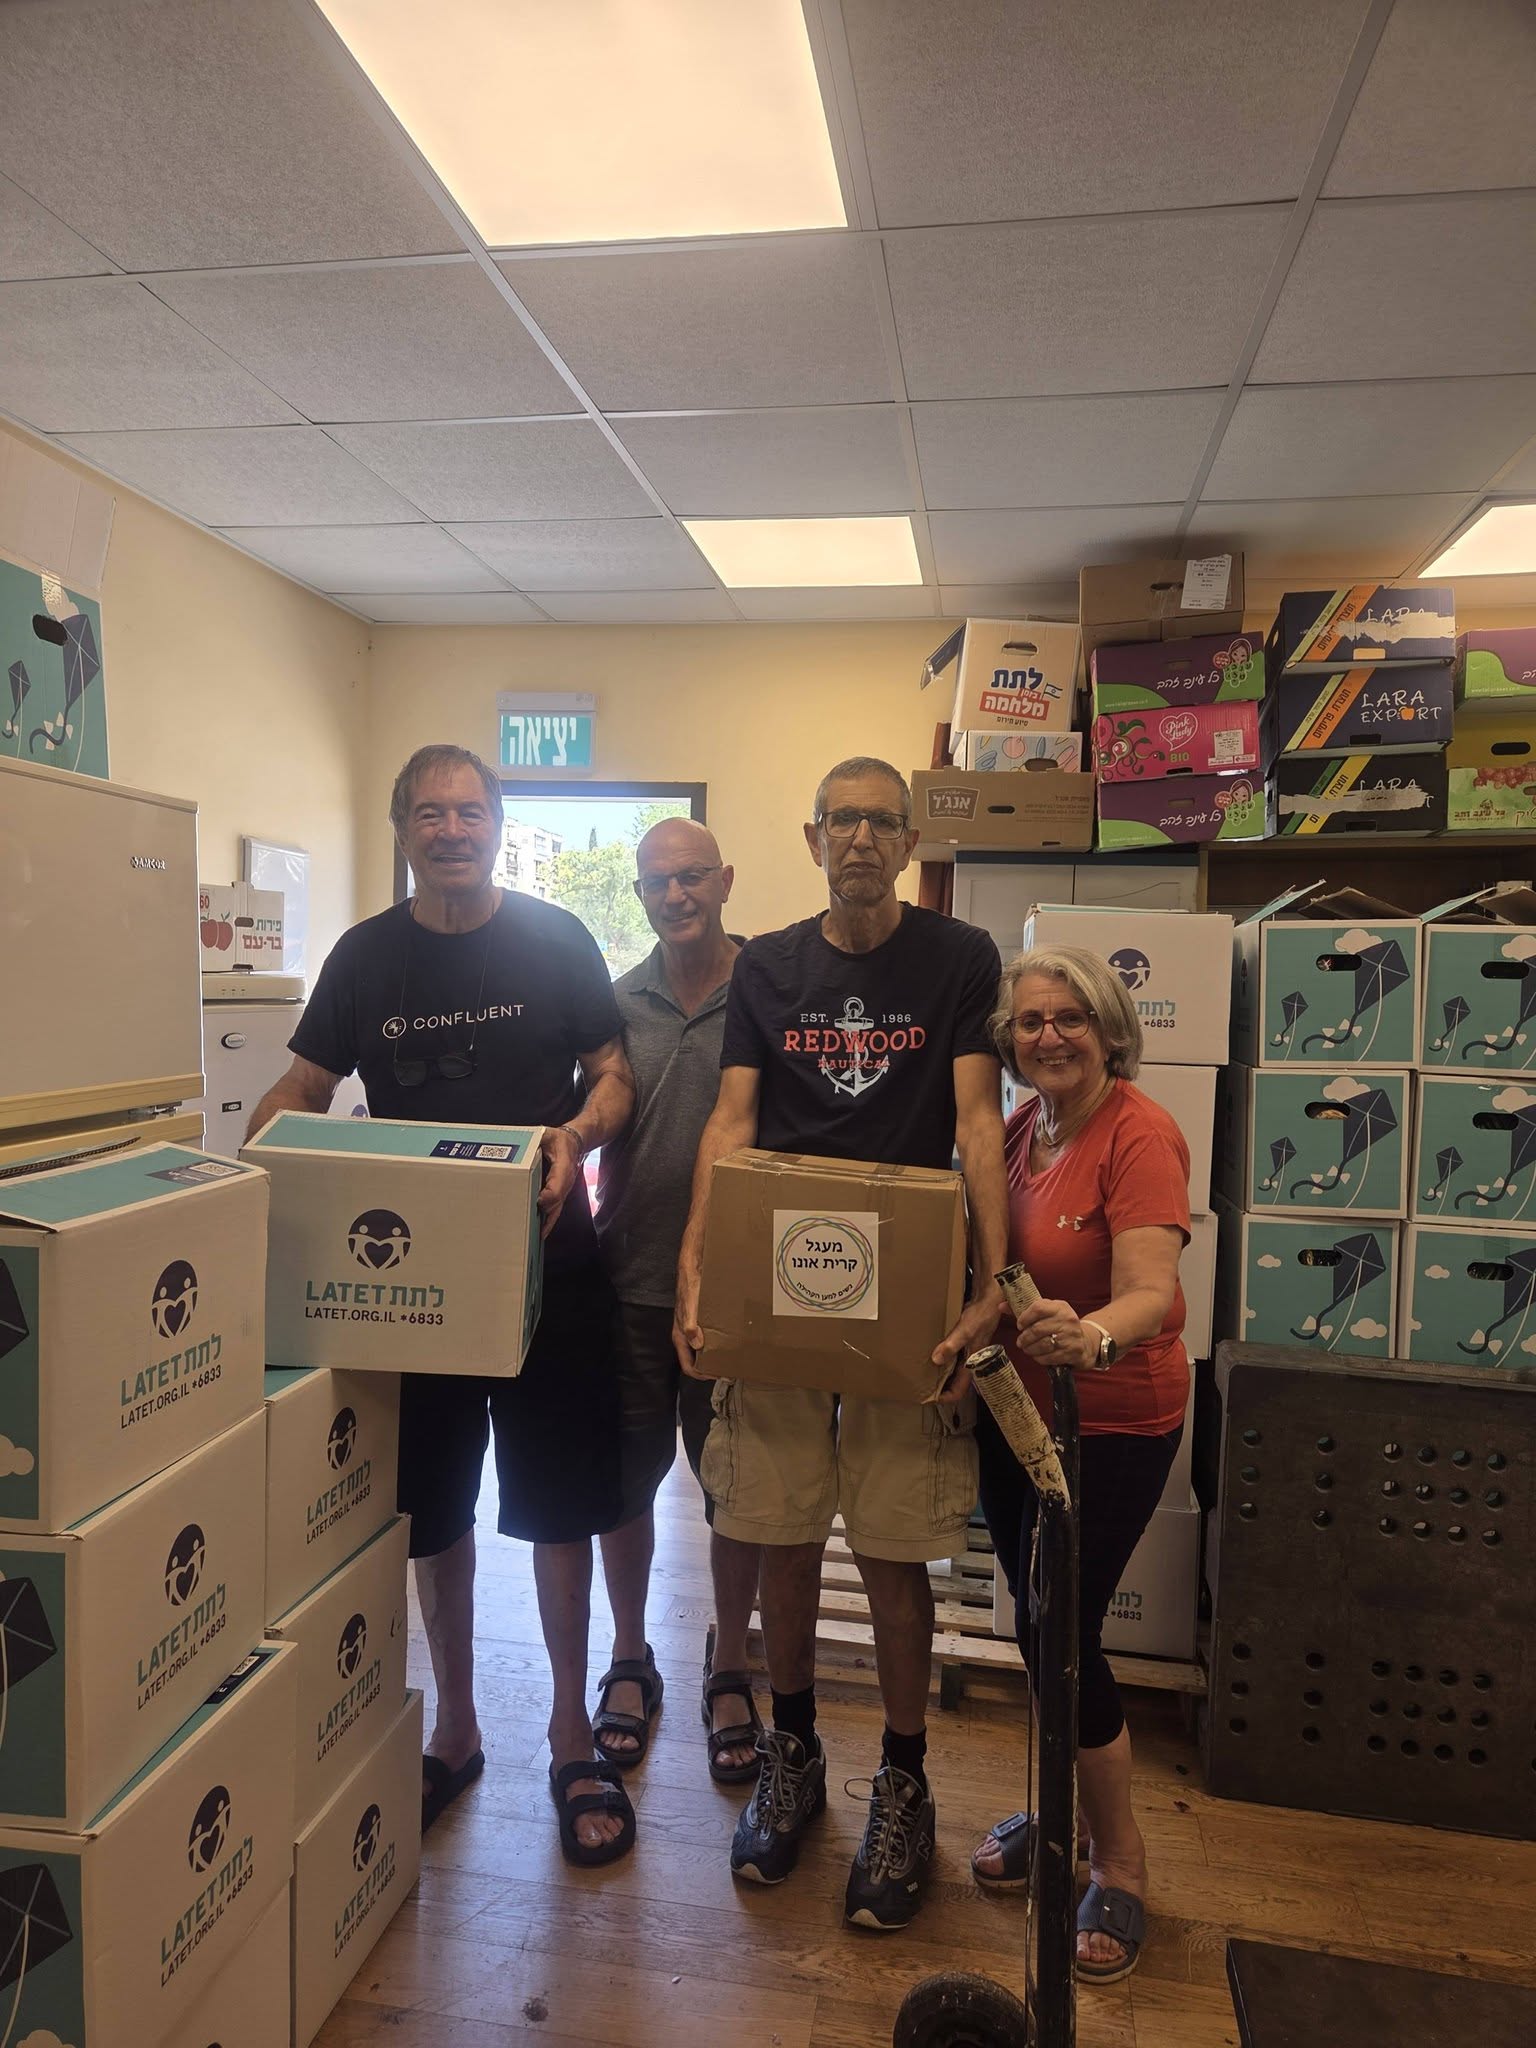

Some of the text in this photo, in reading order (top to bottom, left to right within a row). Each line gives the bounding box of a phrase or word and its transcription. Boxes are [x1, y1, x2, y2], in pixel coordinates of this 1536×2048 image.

[991, 667, 1043, 690] לתת
[1156, 677, 1180, 690] זהב
[1207, 670, 1220, 683] כל
[1020, 688, 1039, 700] בזמן
[1361, 689, 1425, 708] LARA
[984, 695, 1045, 717] מלחמה
[1165, 715, 1190, 734] Pink
[1170, 726, 1195, 741] Lady
[509, 716, 577, 766] יציאה
[1169, 752, 1190, 763] BIO
[933, 794, 971, 810] אנג'ל
[1159, 815, 1183, 827] זהב
[1209, 809, 1222, 822] כל
[256, 919, 282, 932] פירות
[413, 1004, 524, 1030] CONFLUENT
[1137, 1000, 1176, 1016] לתת
[800, 1013, 912, 1024] EST. 1986
[783, 1026, 926, 1053] REDWOOD
[806, 1238, 843, 1253] מעגל
[792, 1257, 858, 1272] קרית אונו
[306, 1280, 444, 1308] LATET לתת
[796, 1281, 853, 1301] נשים למען הקהילה
[305, 1307, 396, 1323] LATET.ORG.IL
[121, 1333, 222, 1407] LATET לתת
[121, 1382, 190, 1429] LATET.ORG.IL
[307, 1459, 371, 1526] LATET לתת
[306, 1502, 351, 1545] LATET.ORG.IL
[137, 1583, 226, 1687] LATET לתת
[137, 1643, 198, 1711] LATET.ORG.IL
[318, 1658, 381, 1743] LATET לתת
[161, 1834, 254, 1966] LATET לתת
[335, 1875, 372, 1941] LATET
[161, 1903, 225, 1989] LATET.ORG.IL
